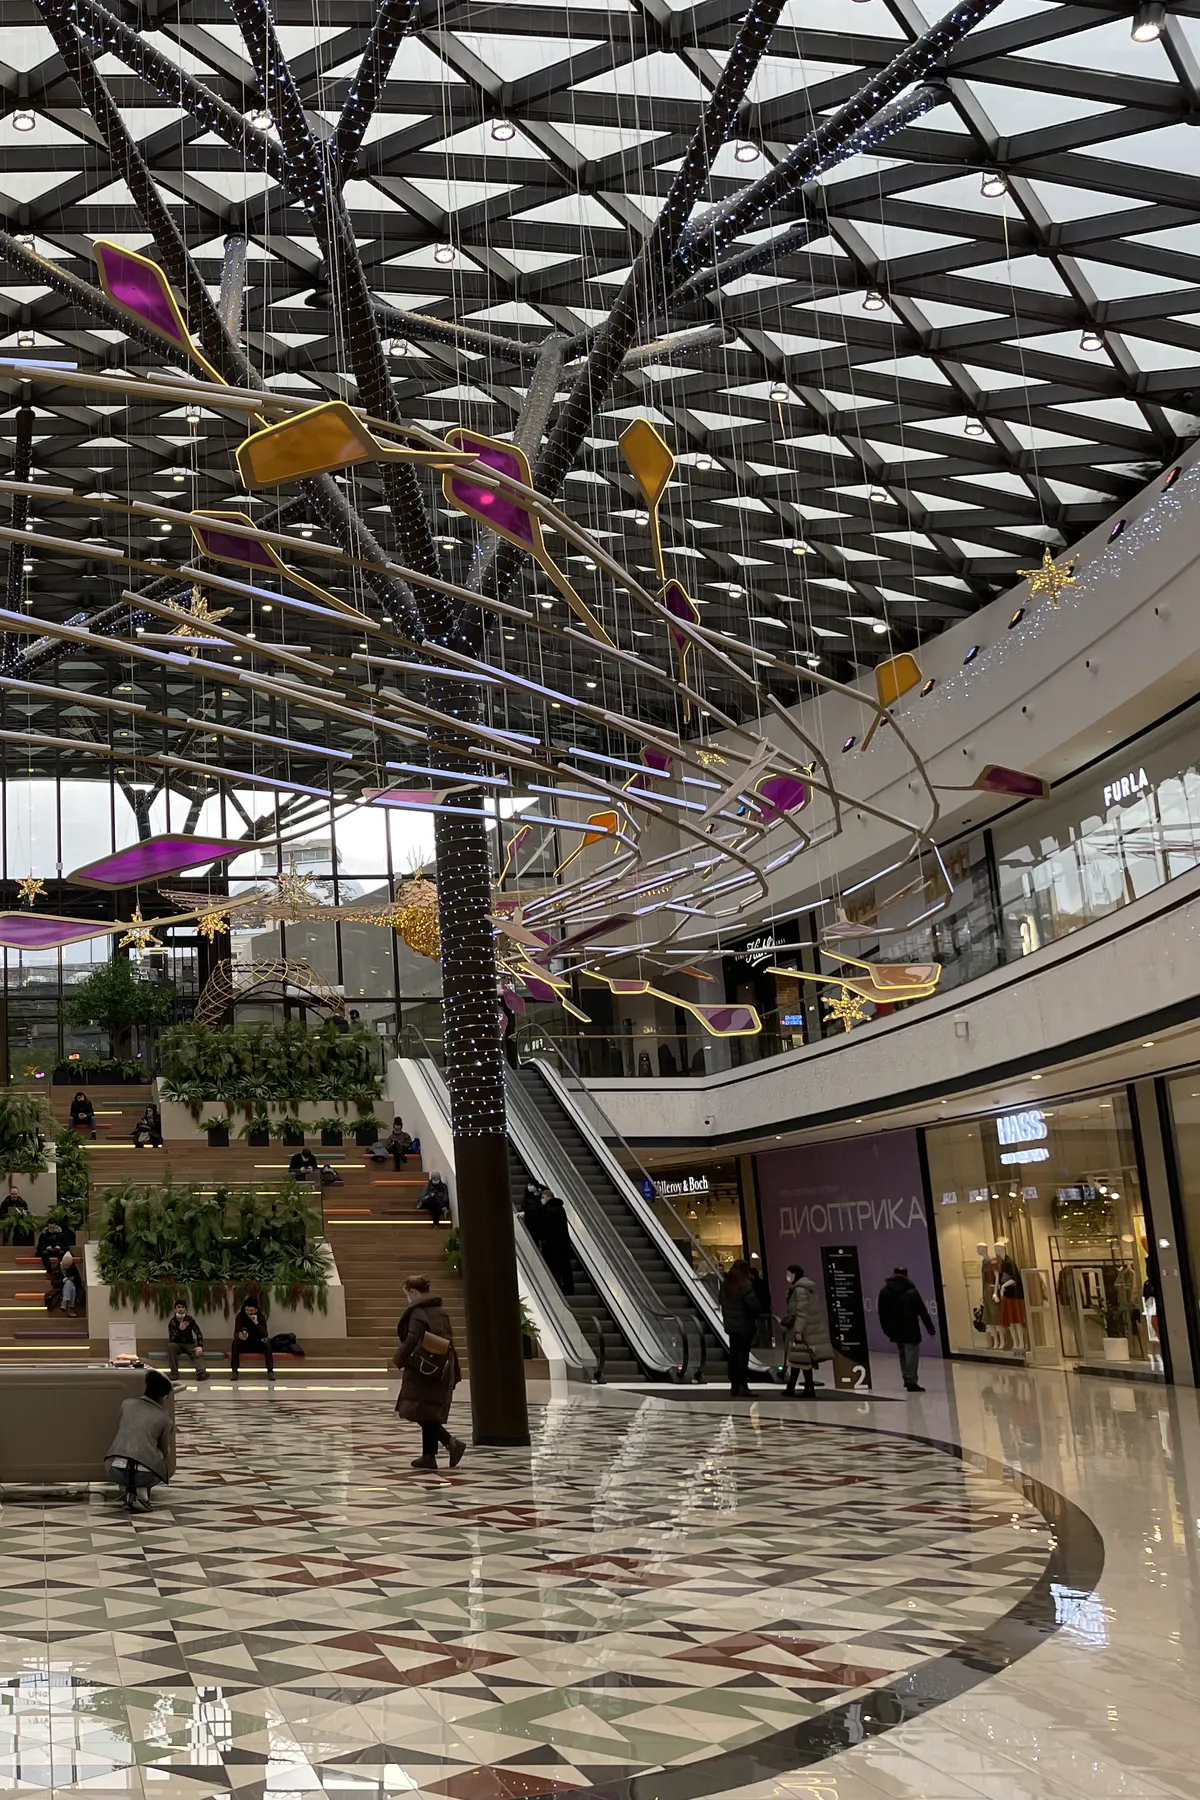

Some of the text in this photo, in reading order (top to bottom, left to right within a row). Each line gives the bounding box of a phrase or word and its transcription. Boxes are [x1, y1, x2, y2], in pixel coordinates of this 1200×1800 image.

[1103, 767, 1149, 807] FURLA
[682, 1179, 689, 1192] &
[688, 1175, 709, 1191] Boch
[779, 1196, 928, 1240] ДИОПТРИКА
[841, 1365, 869, 1389] -2
